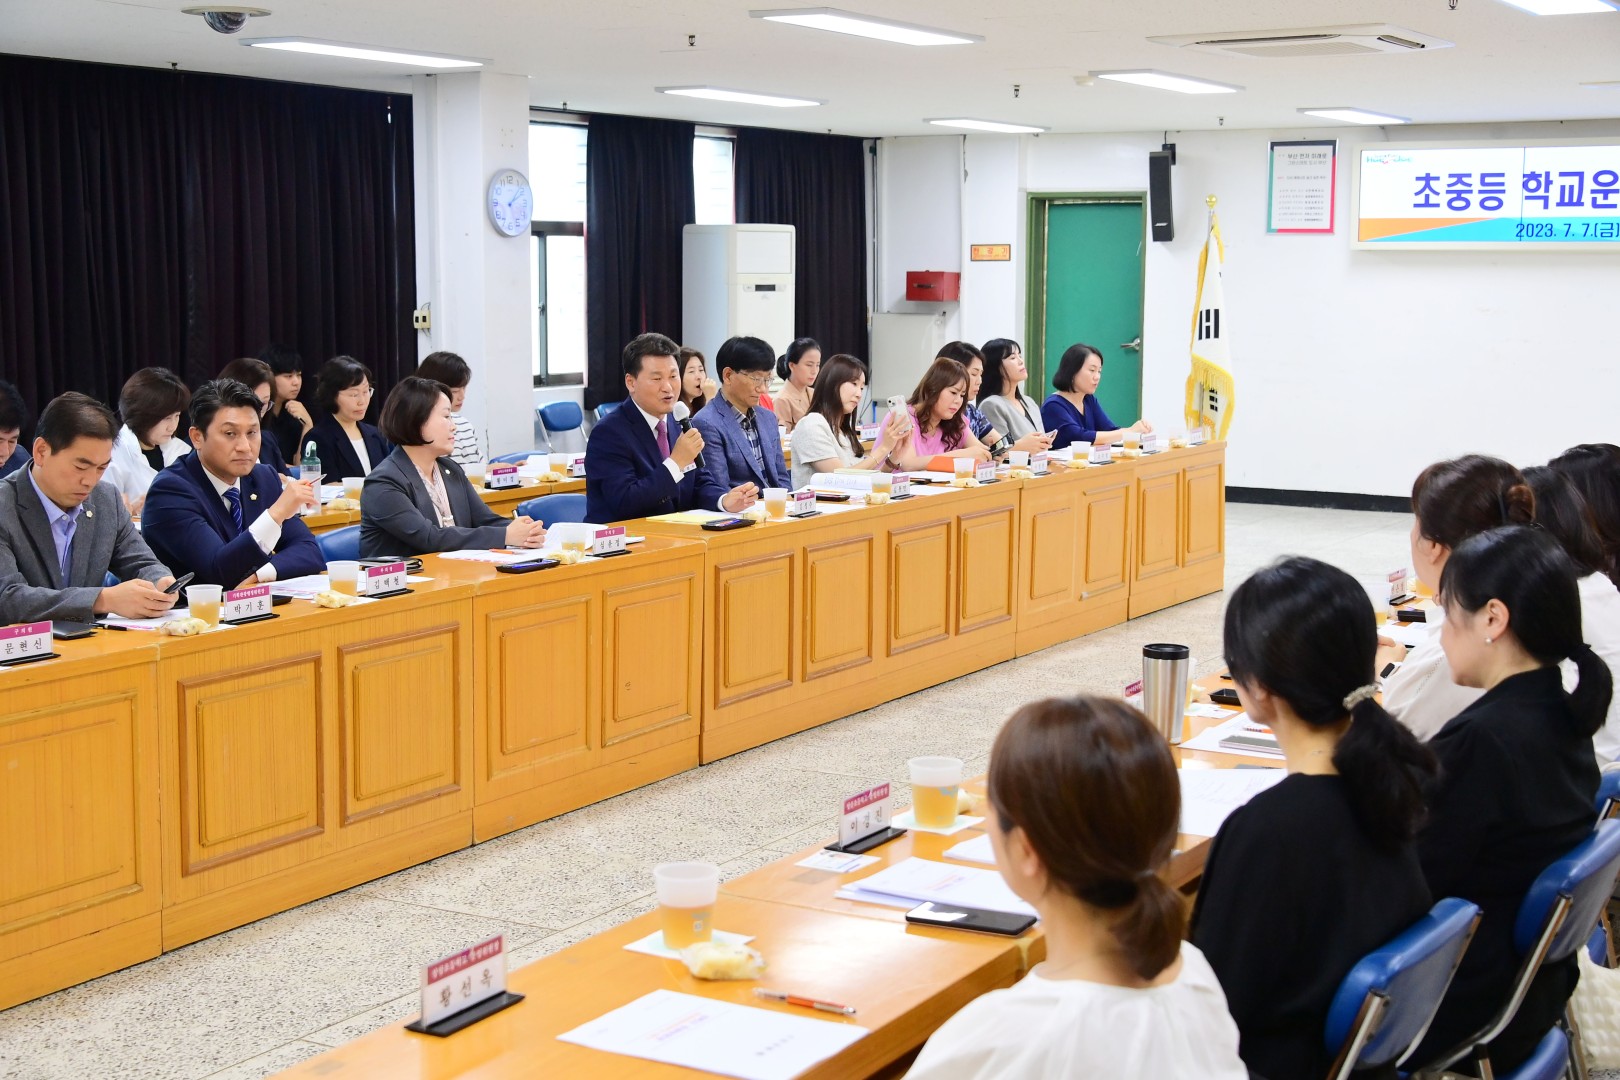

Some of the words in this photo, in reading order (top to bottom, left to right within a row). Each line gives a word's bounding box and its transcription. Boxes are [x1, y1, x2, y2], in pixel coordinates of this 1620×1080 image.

[1413, 172, 1506, 211] 초중등
[1522, 169, 1620, 210] 학교운
[1515, 223, 1557, 238] 2023.
[1563, 223, 1575, 238] 7.
[234, 600, 264, 614] 박기훈
[4, 638, 42, 654] 문현신
